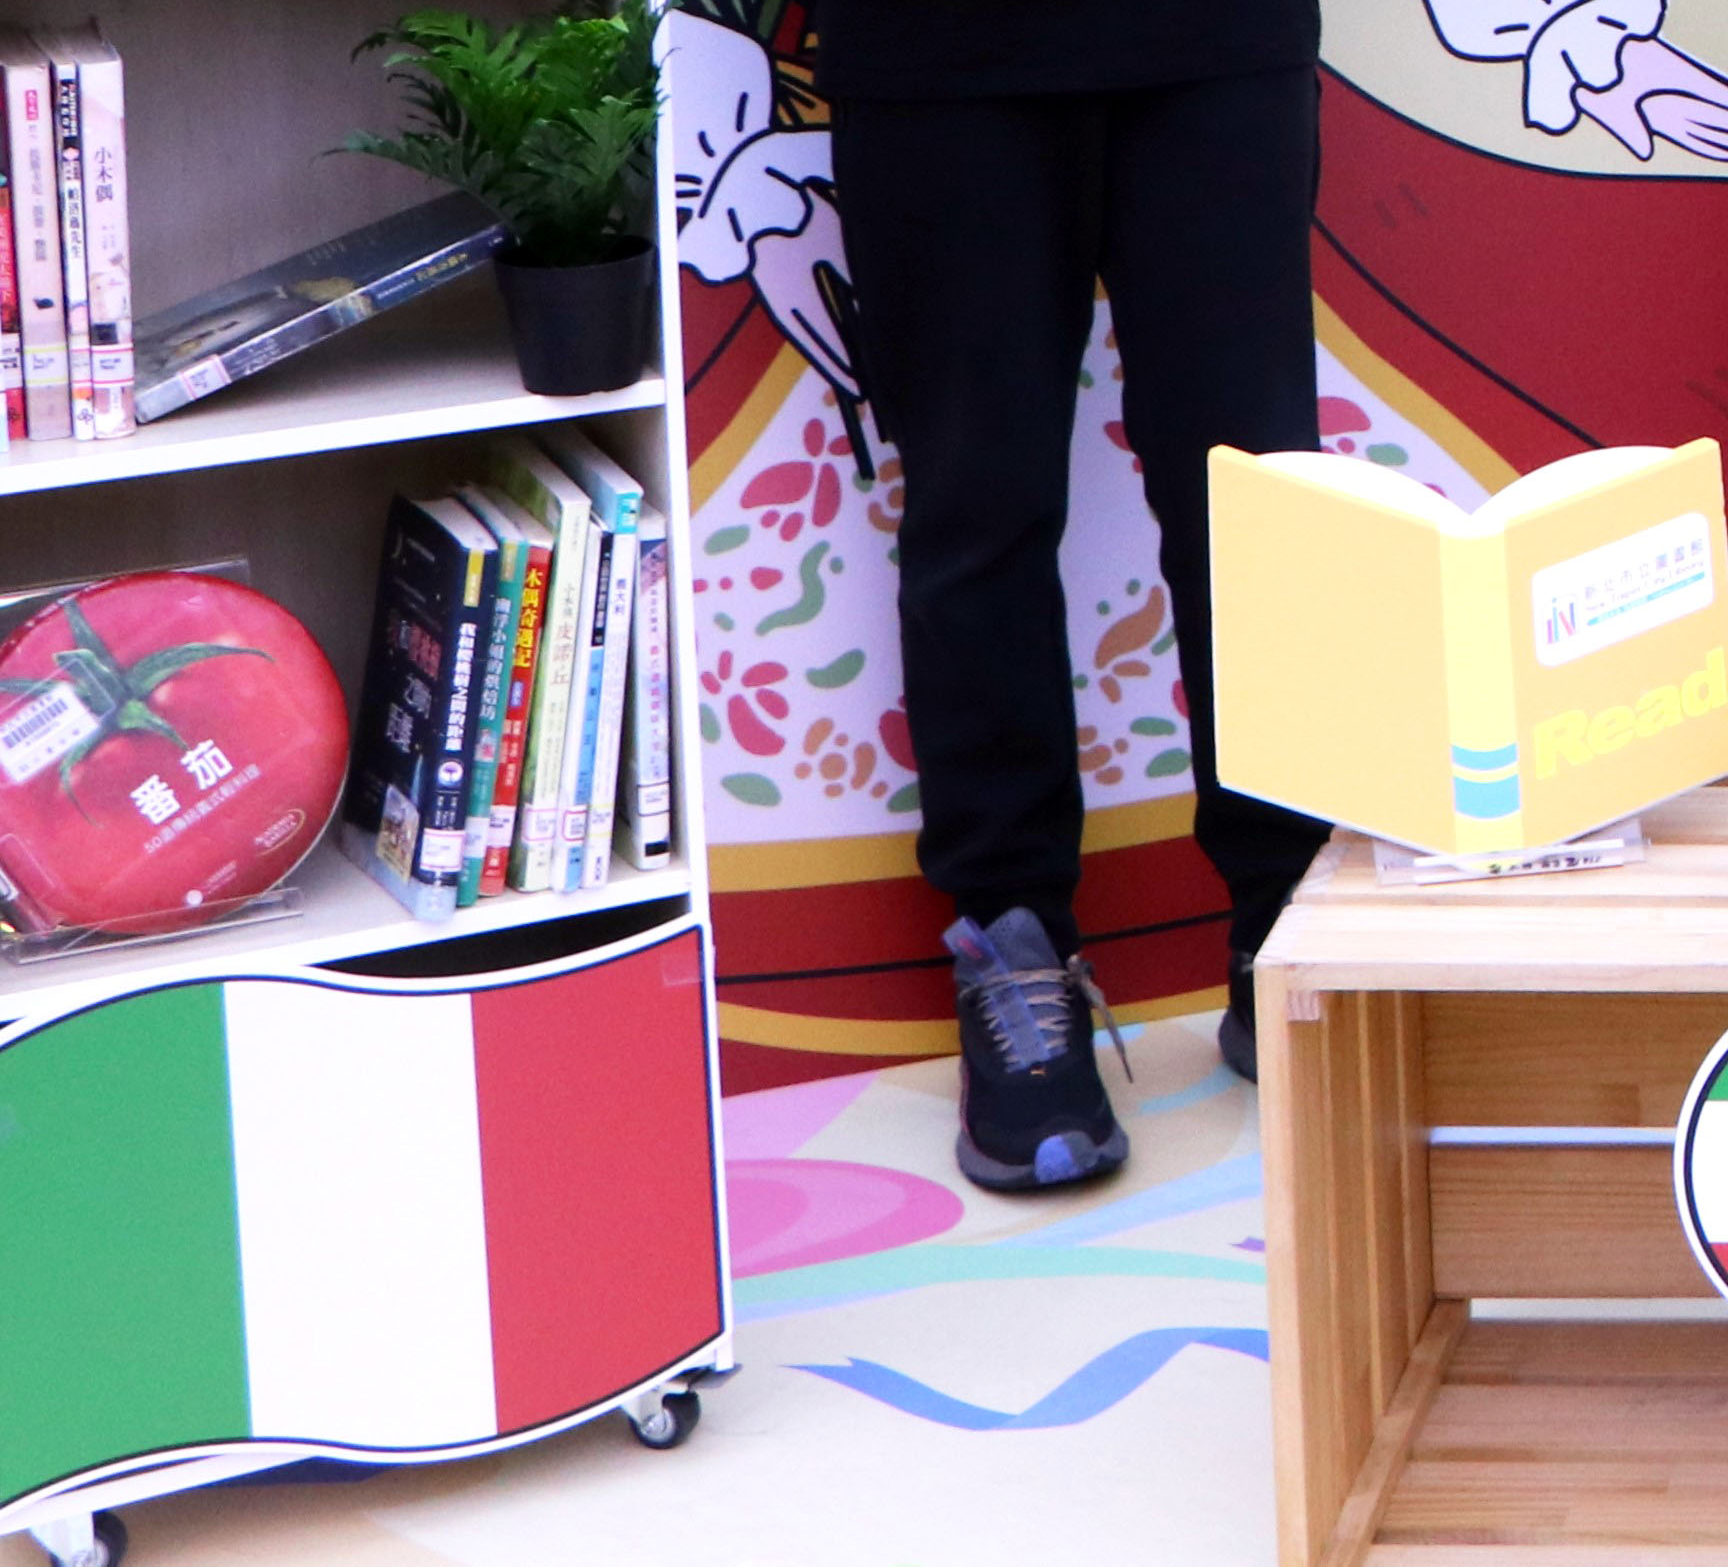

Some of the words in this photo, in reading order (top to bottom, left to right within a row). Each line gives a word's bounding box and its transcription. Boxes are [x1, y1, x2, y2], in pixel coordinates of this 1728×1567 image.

[93, 146, 114, 203] 小木偶
[1531, 646, 1728, 782] Read
[129, 738, 234, 826] 番茄
